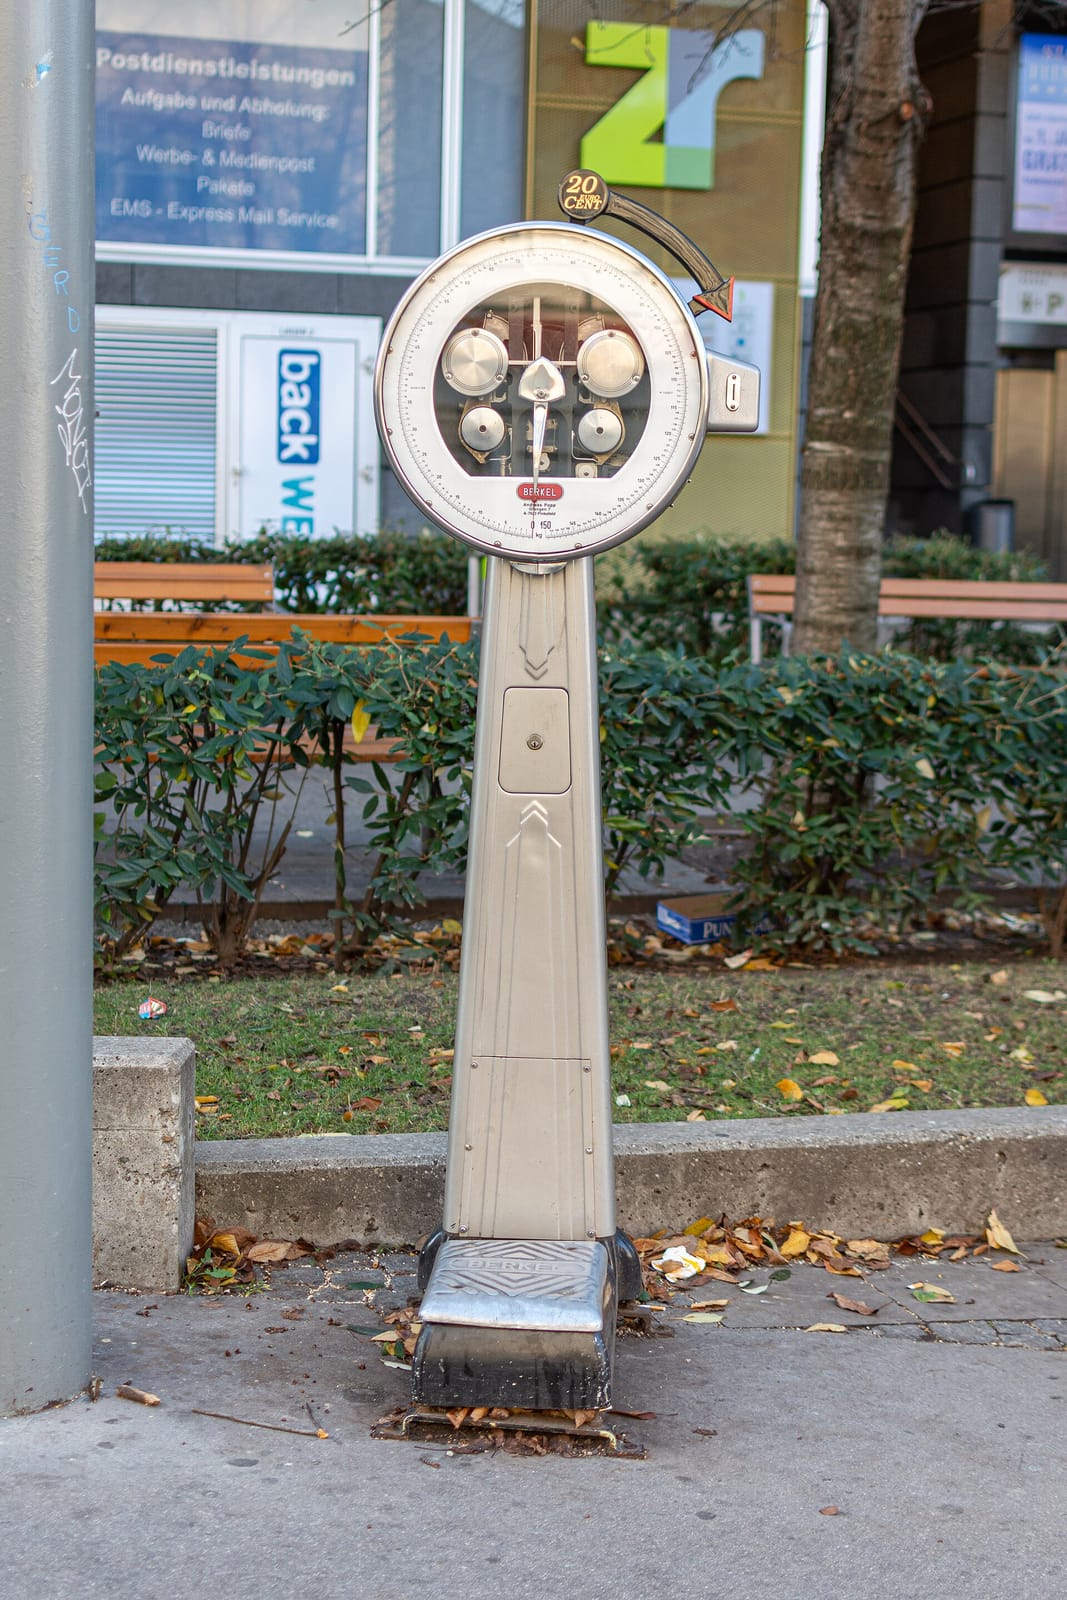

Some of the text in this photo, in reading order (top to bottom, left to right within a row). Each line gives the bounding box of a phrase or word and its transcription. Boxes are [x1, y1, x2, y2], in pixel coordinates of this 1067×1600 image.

[96, 48, 355, 88] Postdienstleistungen
[121, 87, 197, 111] Aufgabe
[200, 94, 236, 113] und
[202, 120, 251, 141] Briefe
[201, 149, 215, 167] &
[197, 176, 256, 197] Pakete
[566, 175, 598, 194] 20
[564, 196, 603, 210] CENT
[110, 199, 152, 218] EMS
[167, 202, 234, 224] Express
[238, 207, 274, 225] Mail
[277, 208, 340, 229] Service
[280, 352, 319, 461] back
[523, 487, 557, 497] BERKEL
[540, 520, 552, 529] 150
